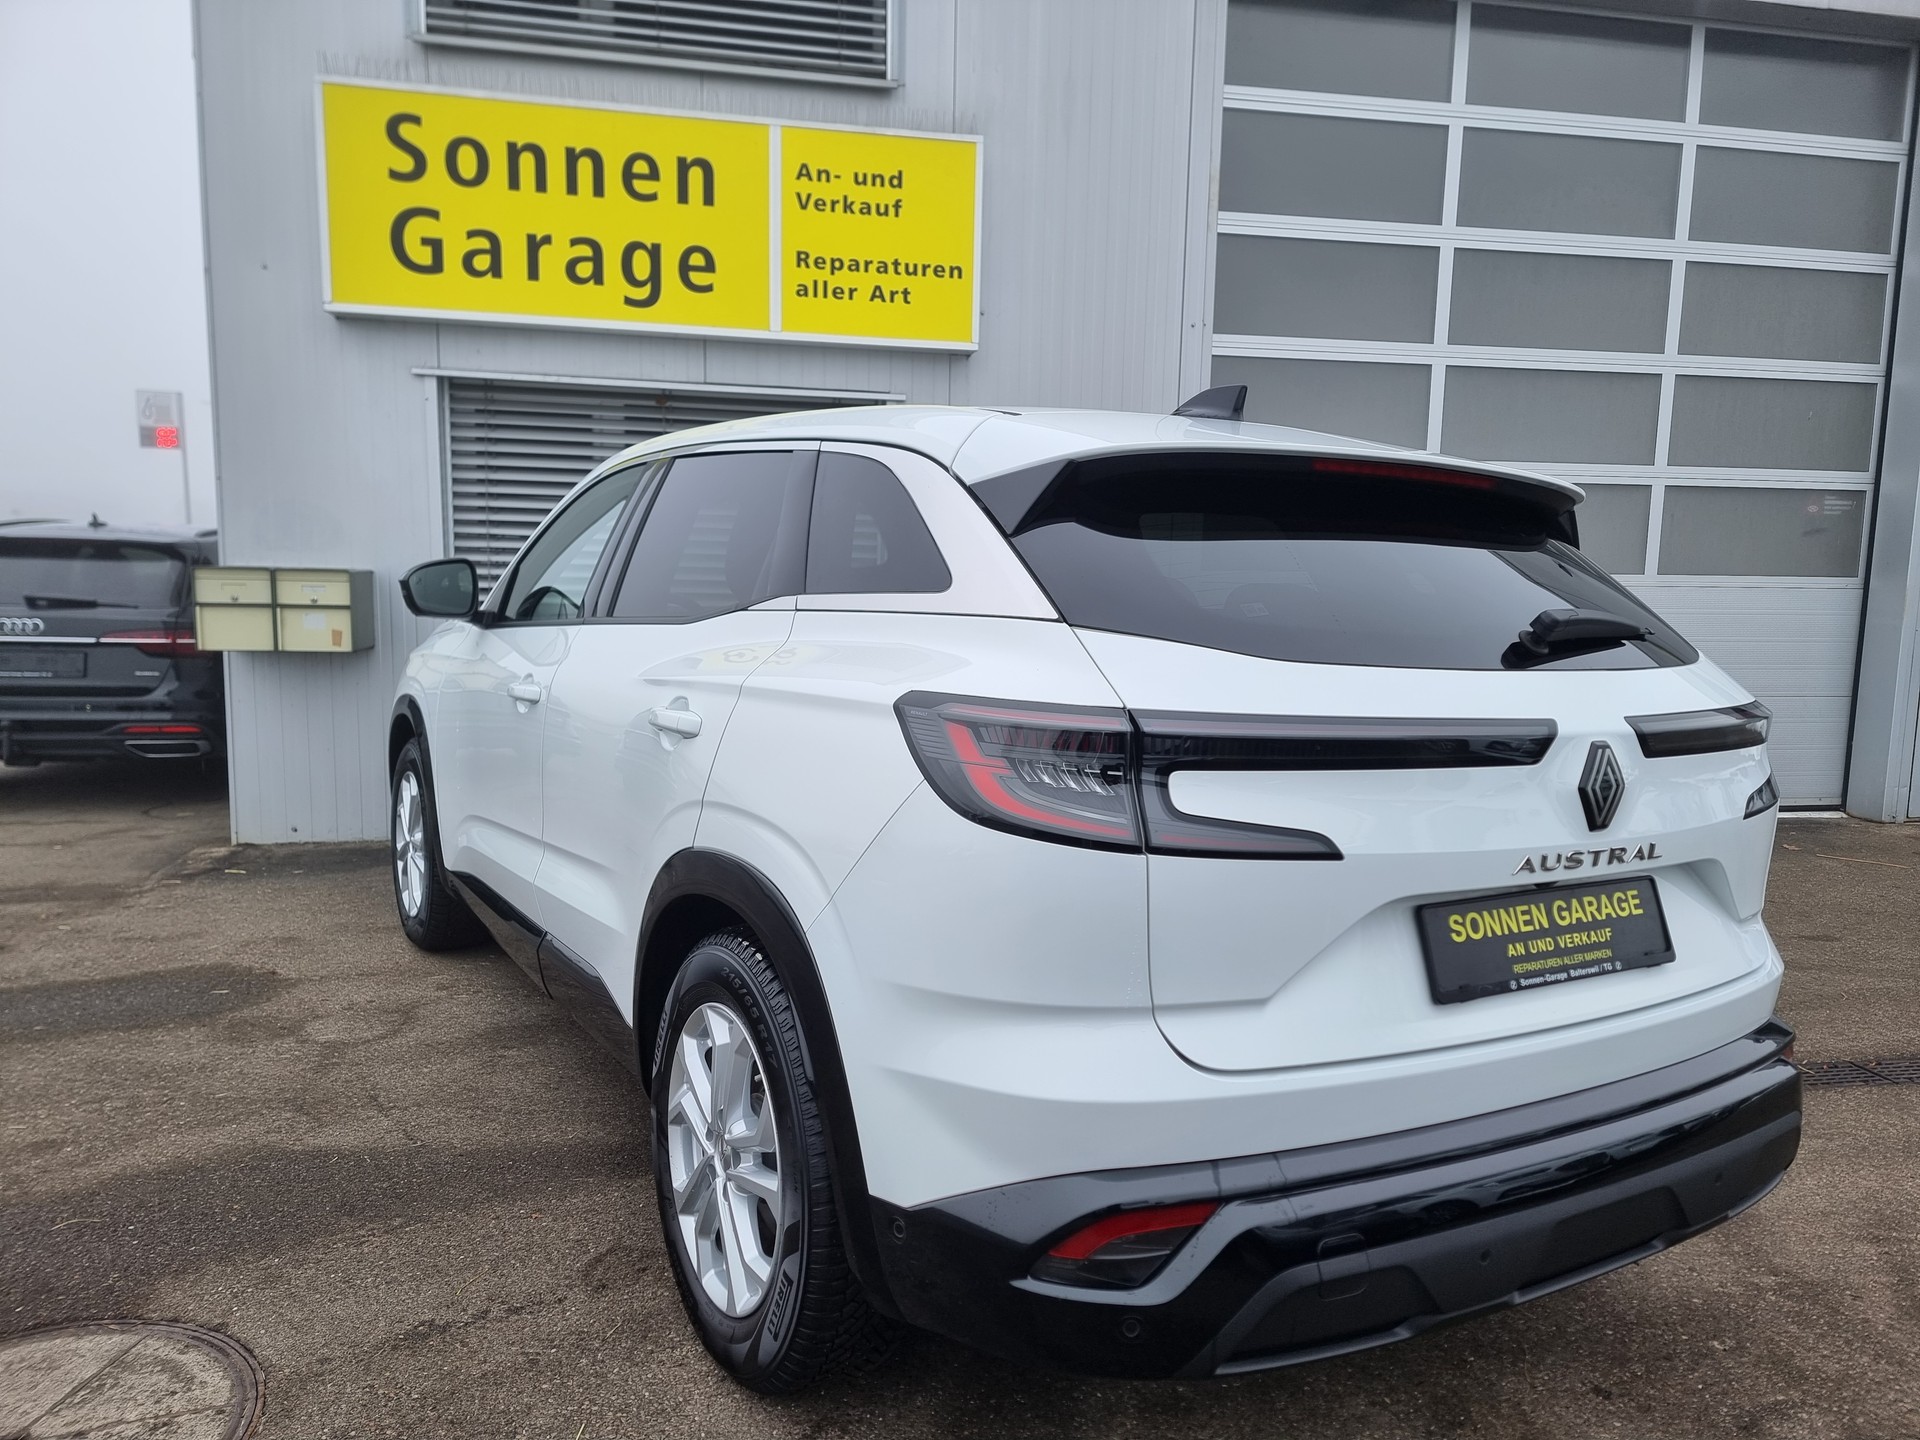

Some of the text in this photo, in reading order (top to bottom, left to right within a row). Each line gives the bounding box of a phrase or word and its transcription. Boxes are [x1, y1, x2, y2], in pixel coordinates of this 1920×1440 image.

[384, 111, 717, 208] Sonnen
[795, 163, 904, 189] An- und
[795, 192, 903, 219] Verkauf
[389, 205, 717, 310] Garage
[795, 250, 964, 281] Reparaturen
[795, 278, 912, 306] aller Art
[1512, 842, 1662, 875] AUSTRAL
[1449, 890, 1643, 942] SONNEN GARAGE
[1508, 928, 1612, 957] AN UND VERKAUF
[1513, 949, 1612, 973] REPARATUREN ALLER MARKEN
[1520, 973, 1568, 987] Sonnen-Garage
[1570, 966, 1599, 977] Balterswil
[1603, 962, 1612, 971] TG
[719, 965, 778, 1069] 215/65 R17
[767, 1268, 795, 1343] PIRELLI
